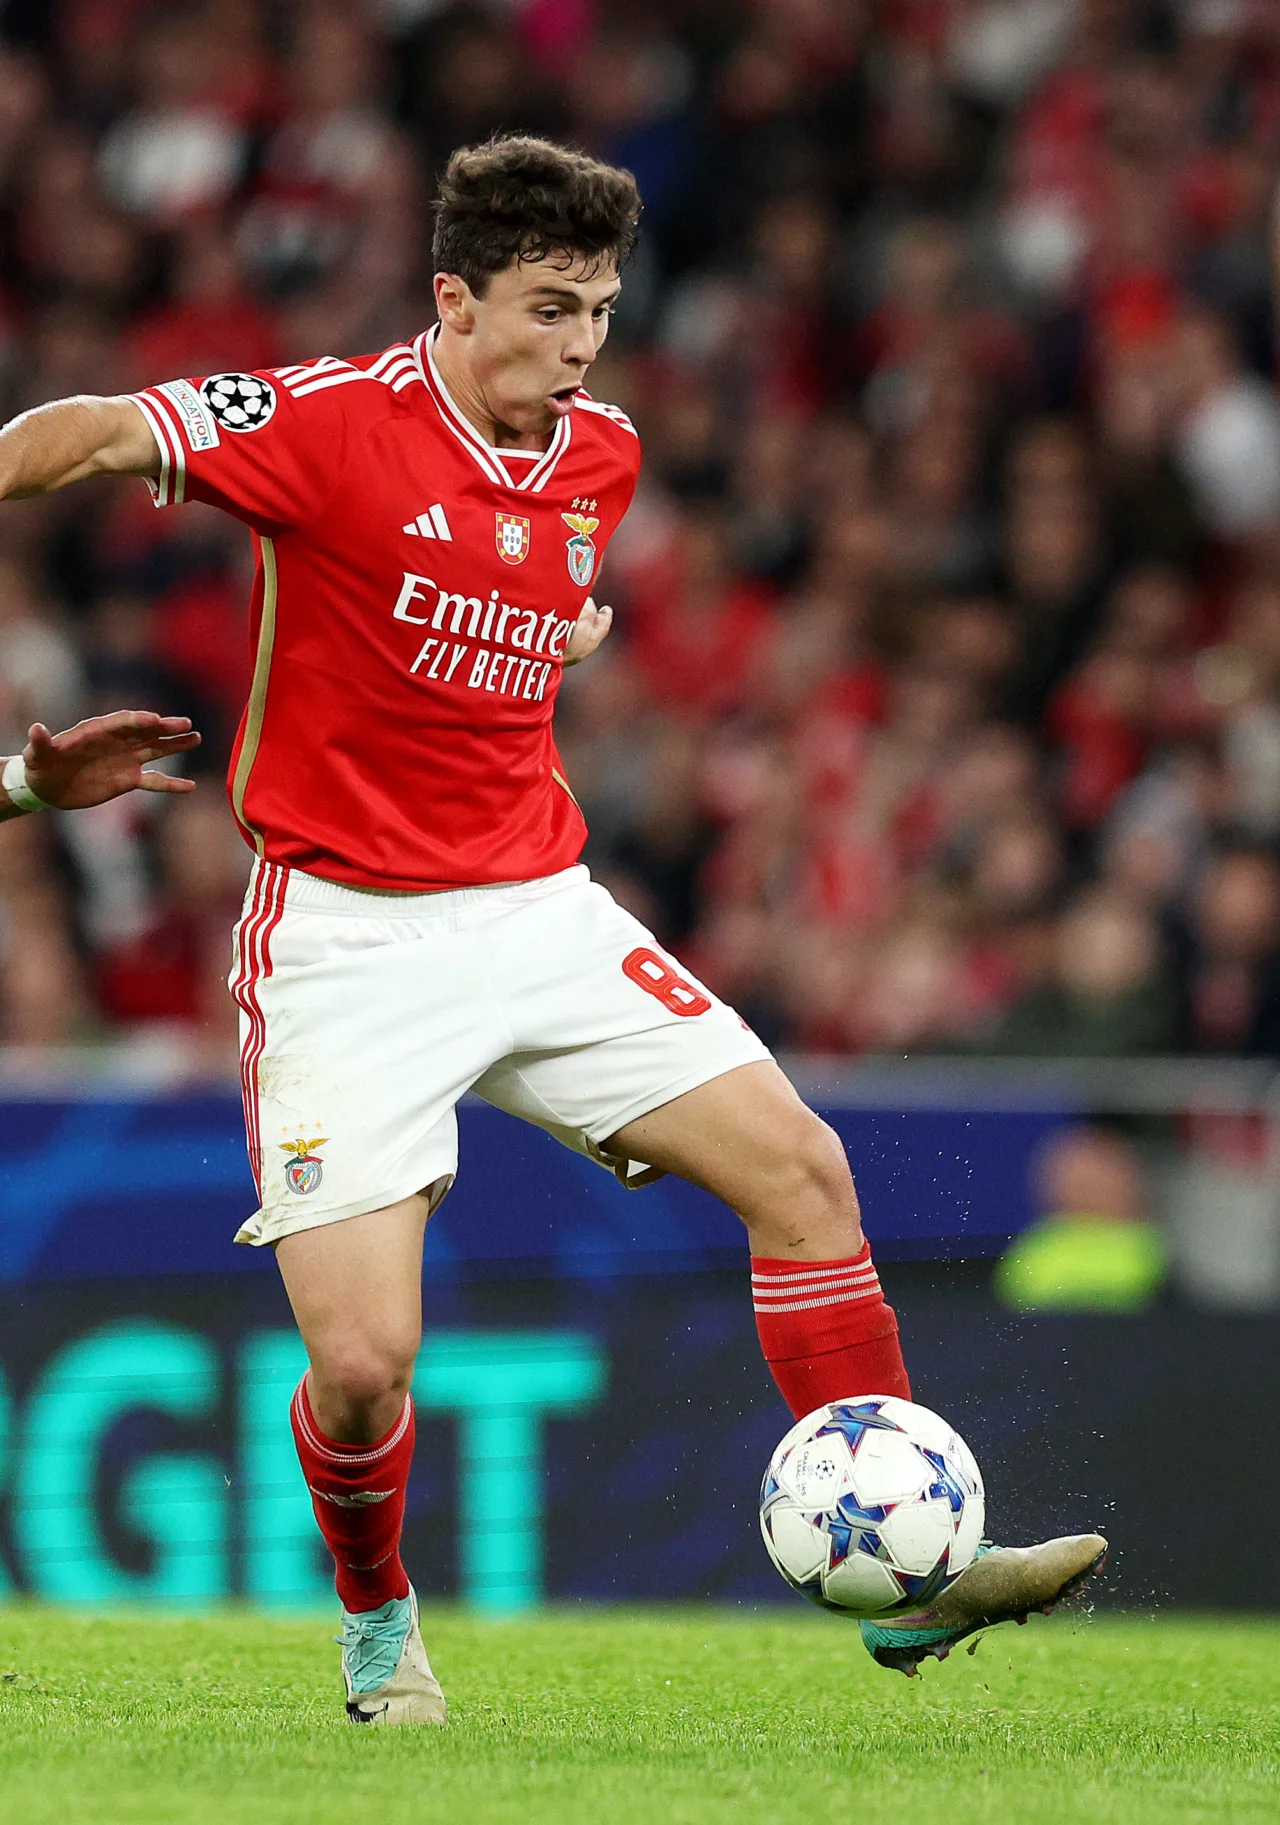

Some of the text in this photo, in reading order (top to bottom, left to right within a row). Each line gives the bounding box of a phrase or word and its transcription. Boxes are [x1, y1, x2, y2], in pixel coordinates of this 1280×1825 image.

[166, 382, 210, 447] OUNDATION
[409, 637, 552, 702] FLY BETTER
